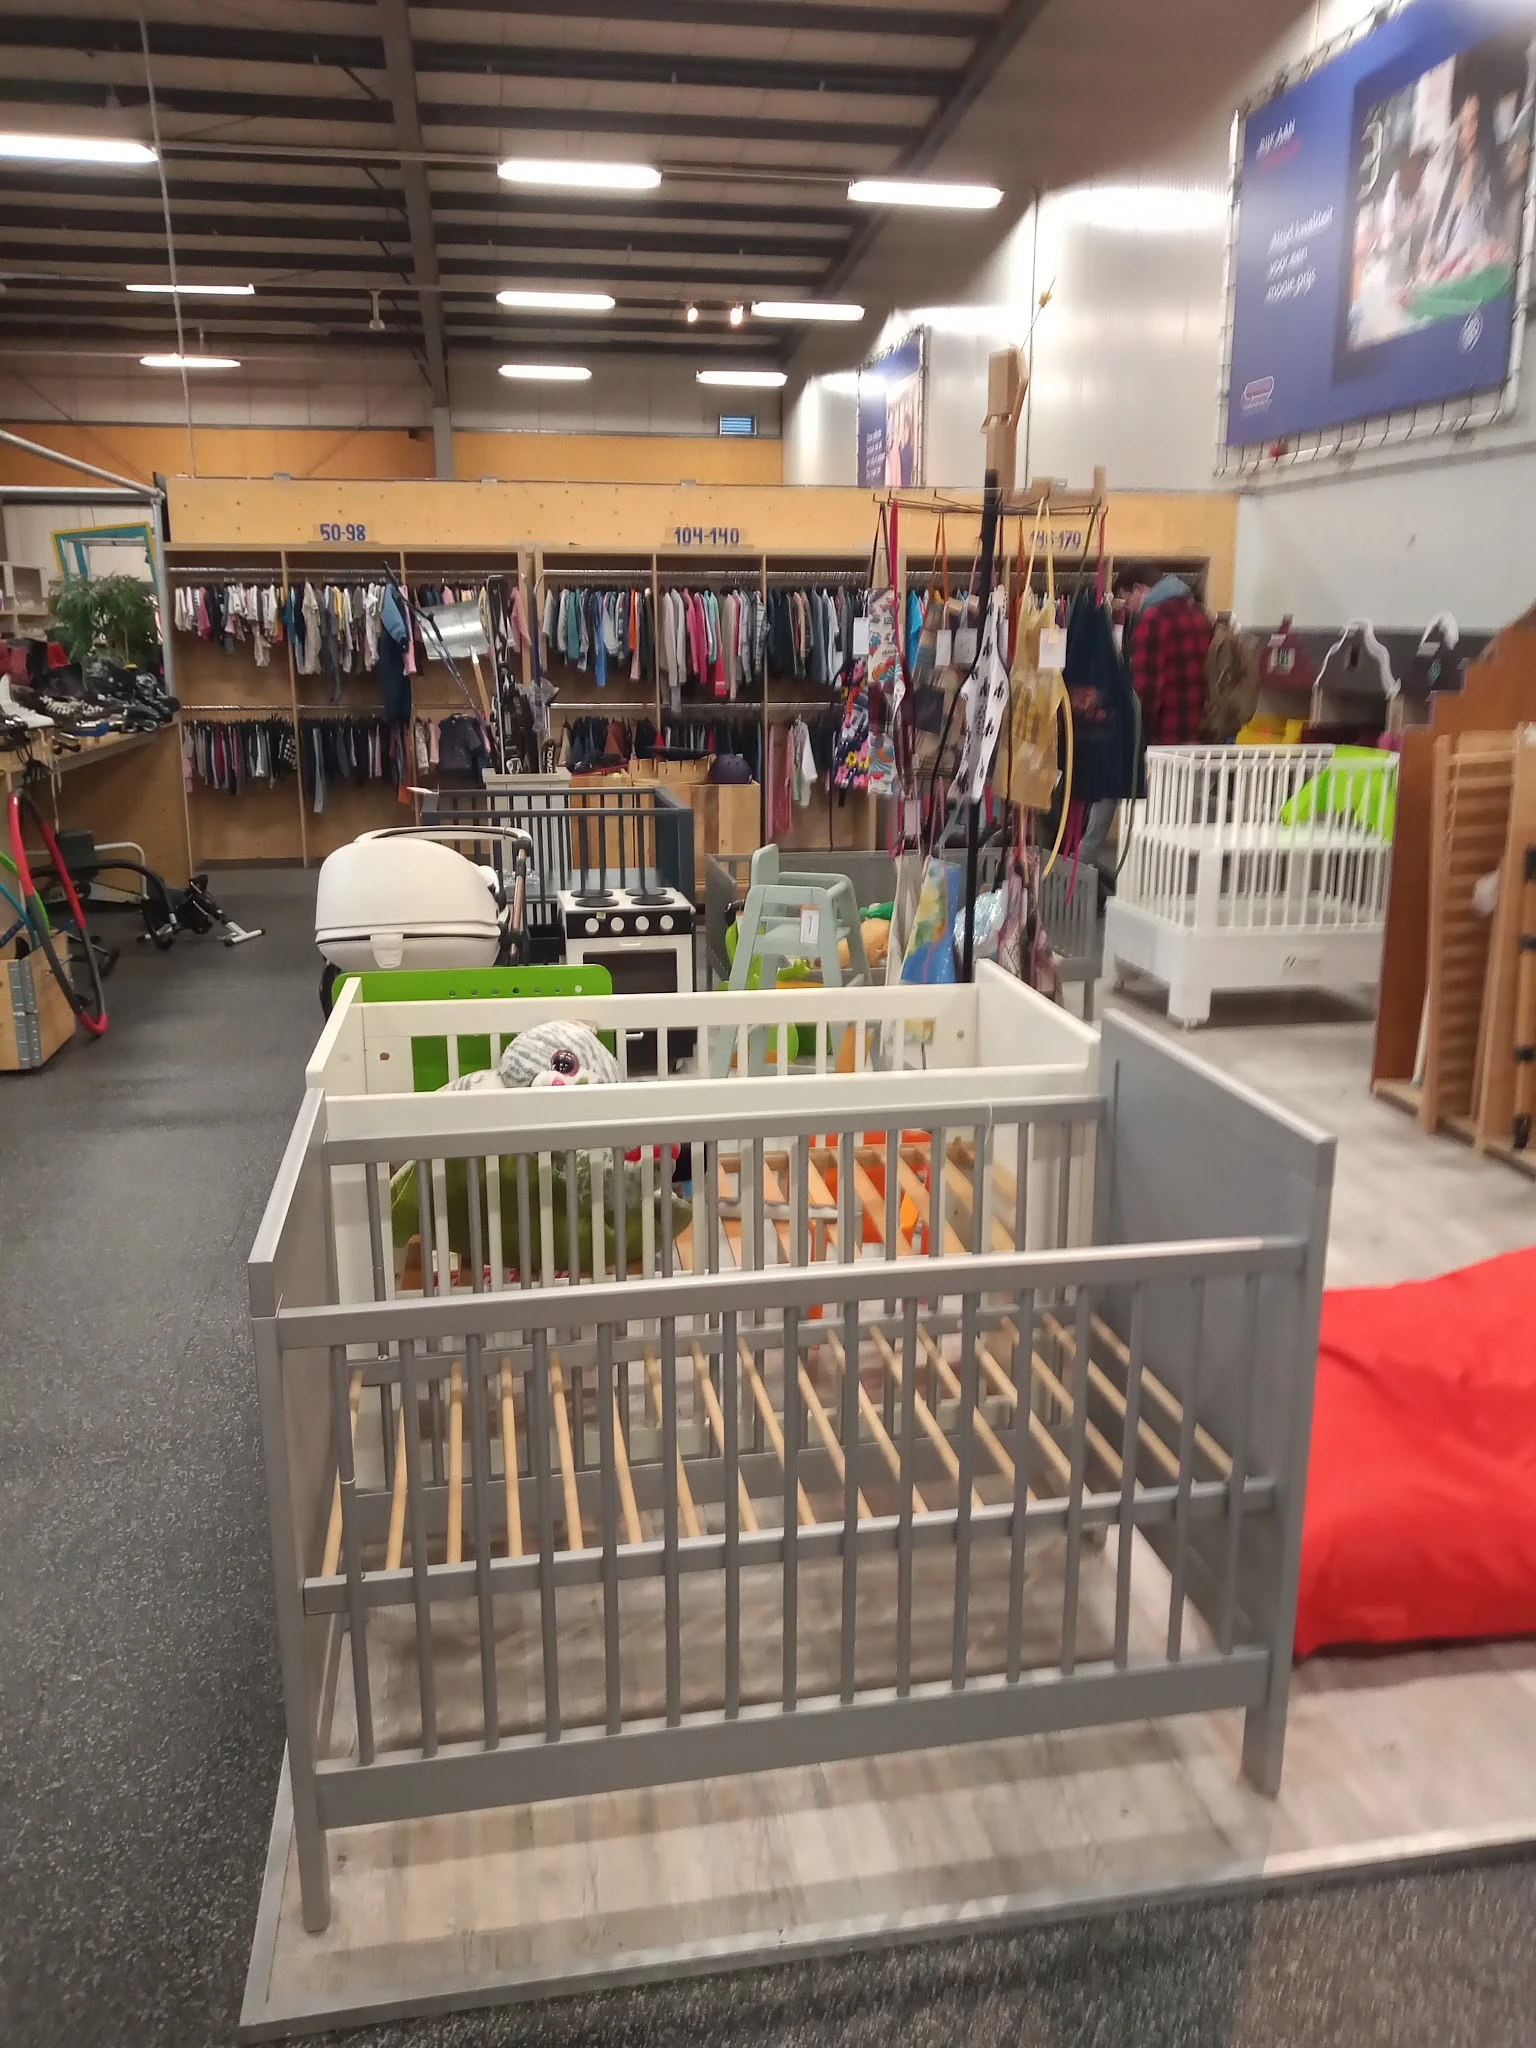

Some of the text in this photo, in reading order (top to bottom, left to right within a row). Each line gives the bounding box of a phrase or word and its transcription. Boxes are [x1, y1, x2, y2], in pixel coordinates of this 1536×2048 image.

[1293, 265, 1316, 298] prijs
[320, 523, 366, 541] 50-98
[674, 526, 740, 544] 104-140
